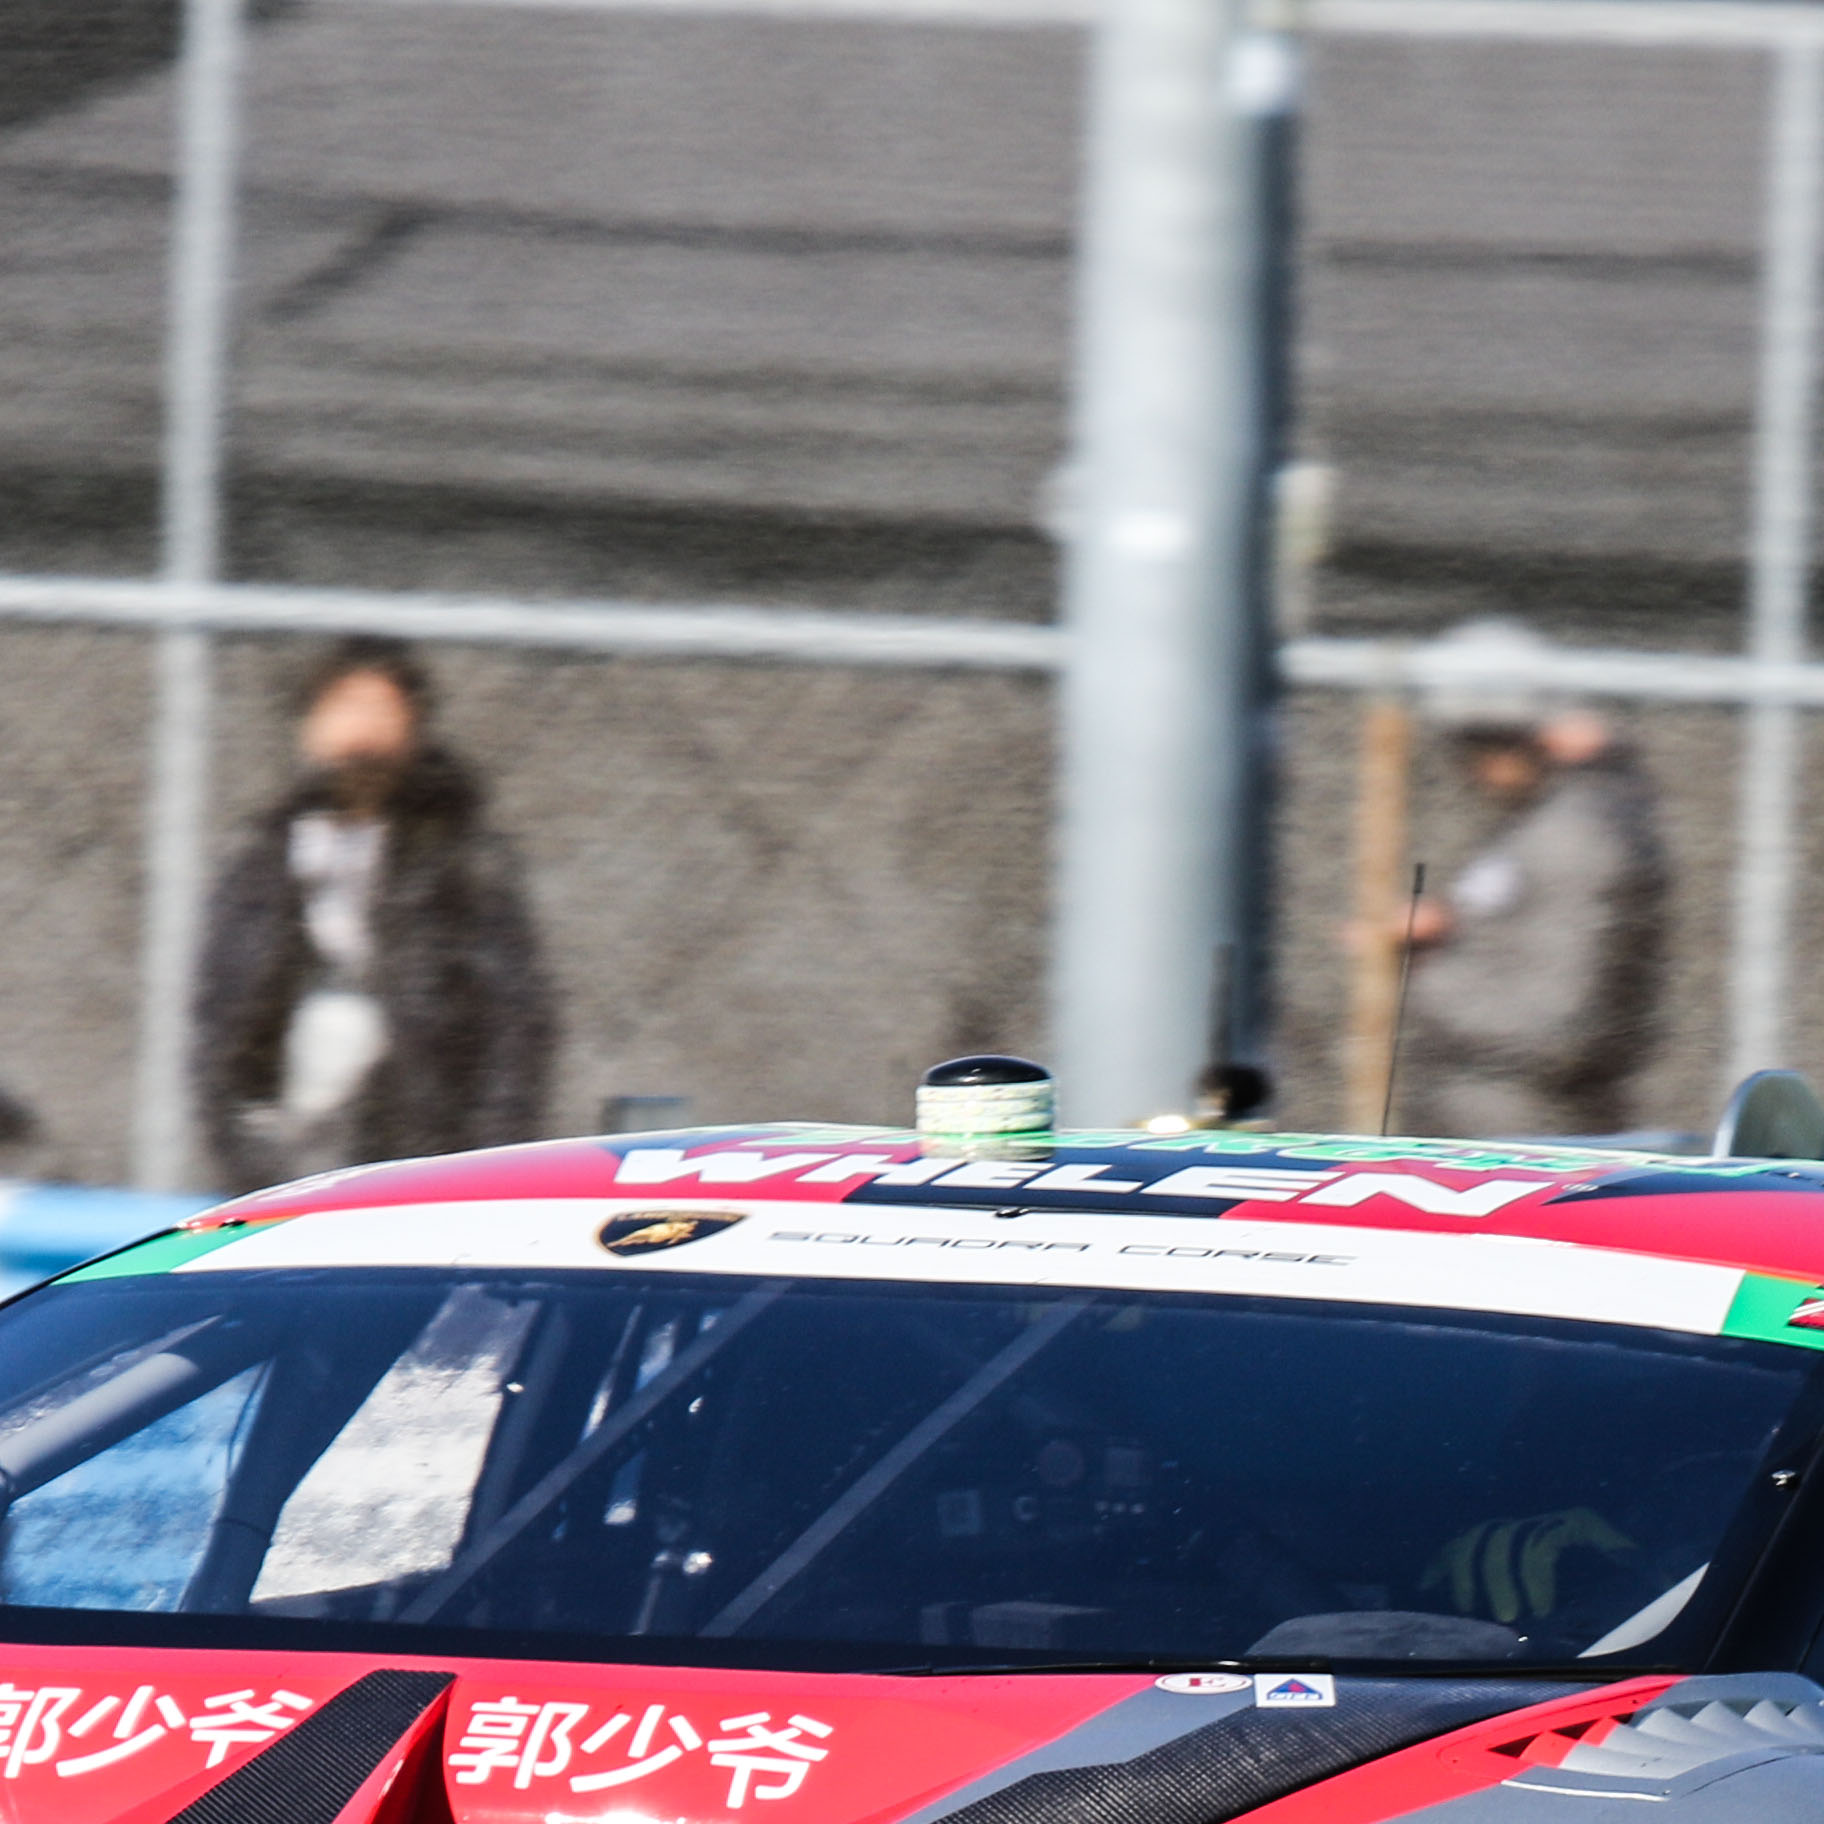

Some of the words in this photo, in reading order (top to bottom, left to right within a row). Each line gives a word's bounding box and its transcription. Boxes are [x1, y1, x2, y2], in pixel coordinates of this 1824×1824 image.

[614, 1148, 1556, 1218] WHELEN
[768, 1229, 1090, 1254] SQUADRA
[1118, 1243, 1357, 1266] CORSE
[448, 1695, 834, 1809] 郭少爷
